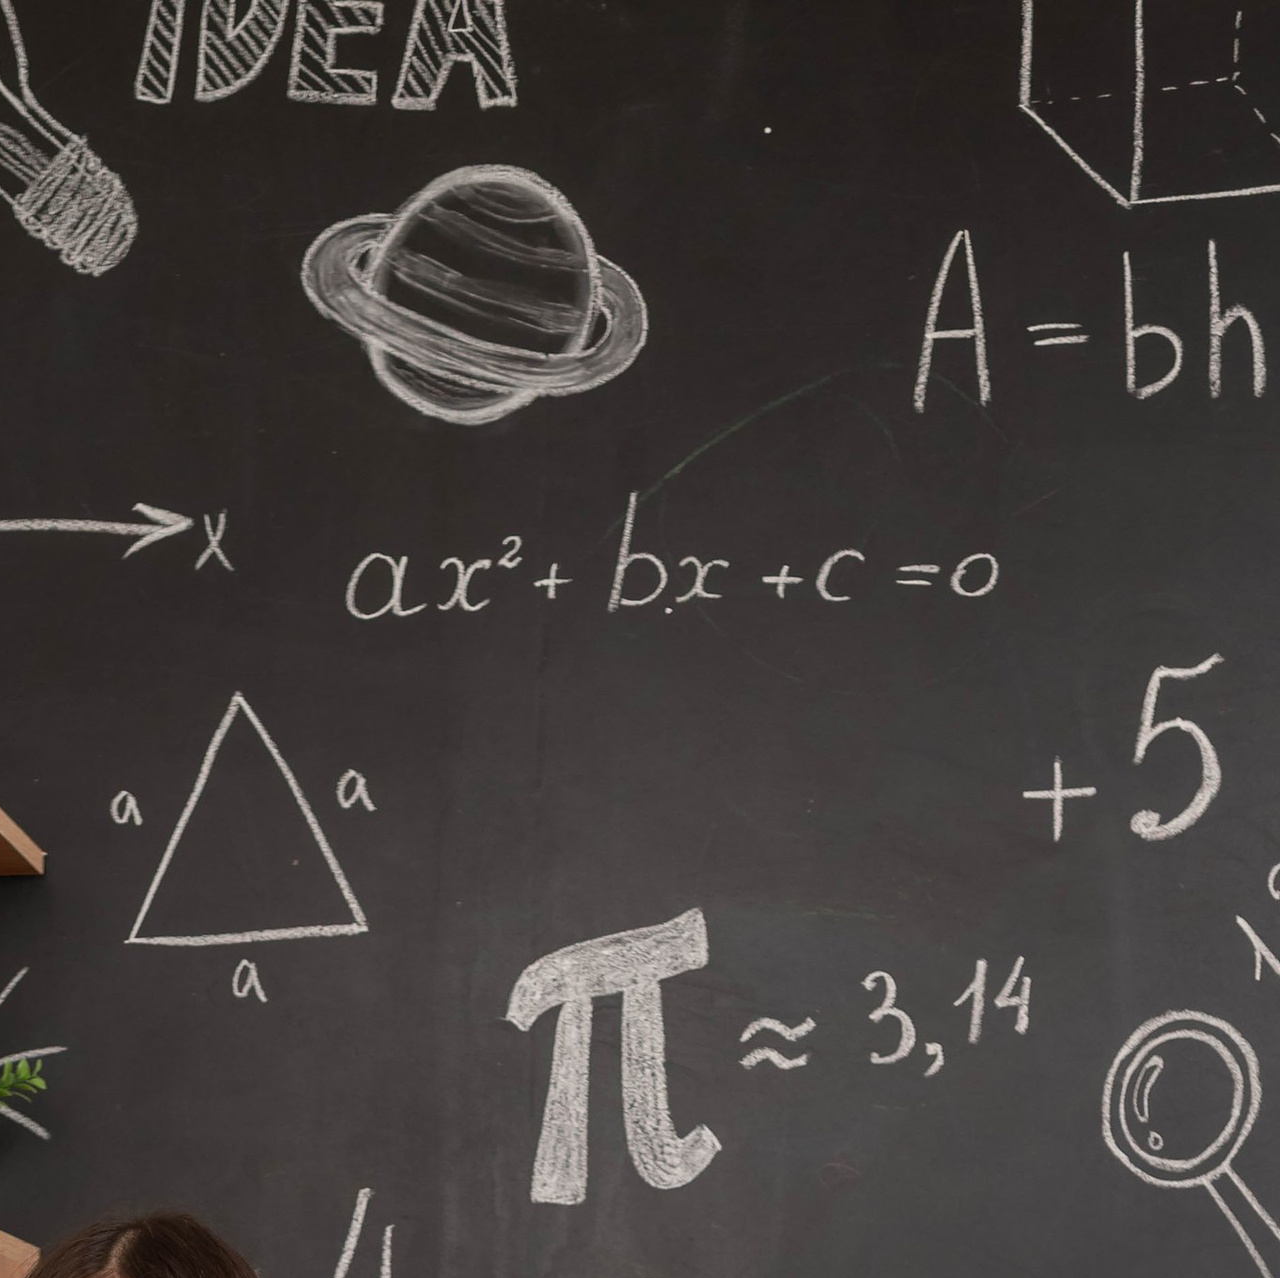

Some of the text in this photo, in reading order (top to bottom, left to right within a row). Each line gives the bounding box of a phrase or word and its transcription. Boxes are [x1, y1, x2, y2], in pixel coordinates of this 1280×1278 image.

[135, 0, 518, 111] IDEA
[913, 229, 991, 413] A
[1122, 239, 1267, 400] bh
[110, 790, 143, 826] a
[335, 768, 378, 812] a
[231, 958, 268, 1003] a
[860, 955, 1032, 1077] 3,14
